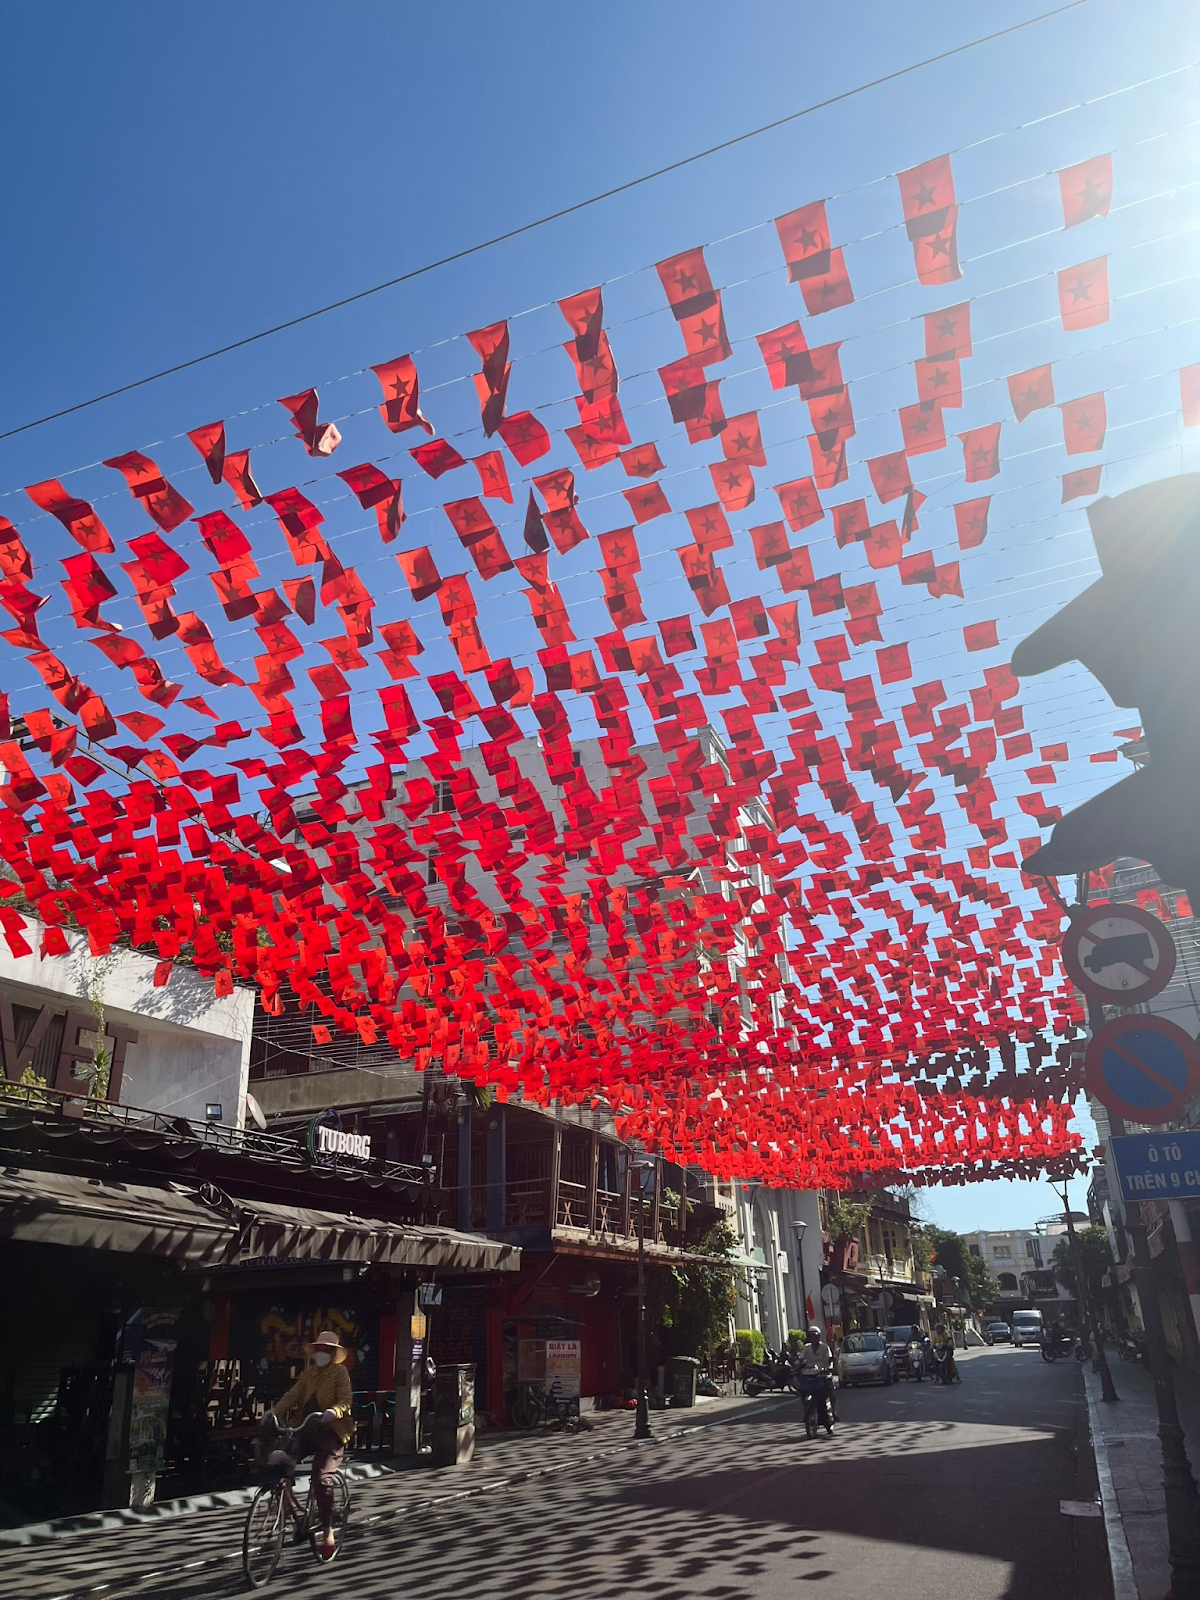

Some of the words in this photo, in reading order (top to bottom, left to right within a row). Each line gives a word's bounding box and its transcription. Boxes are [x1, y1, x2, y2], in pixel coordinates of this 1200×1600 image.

[318, 1125, 371, 1160] TUBORG
[1148, 1143, 1159, 1163] Ô
[1161, 1142, 1182, 1162] TÔ
[1125, 1170, 1167, 1191] TRÊN
[1169, 1172, 1181, 1187] 9
